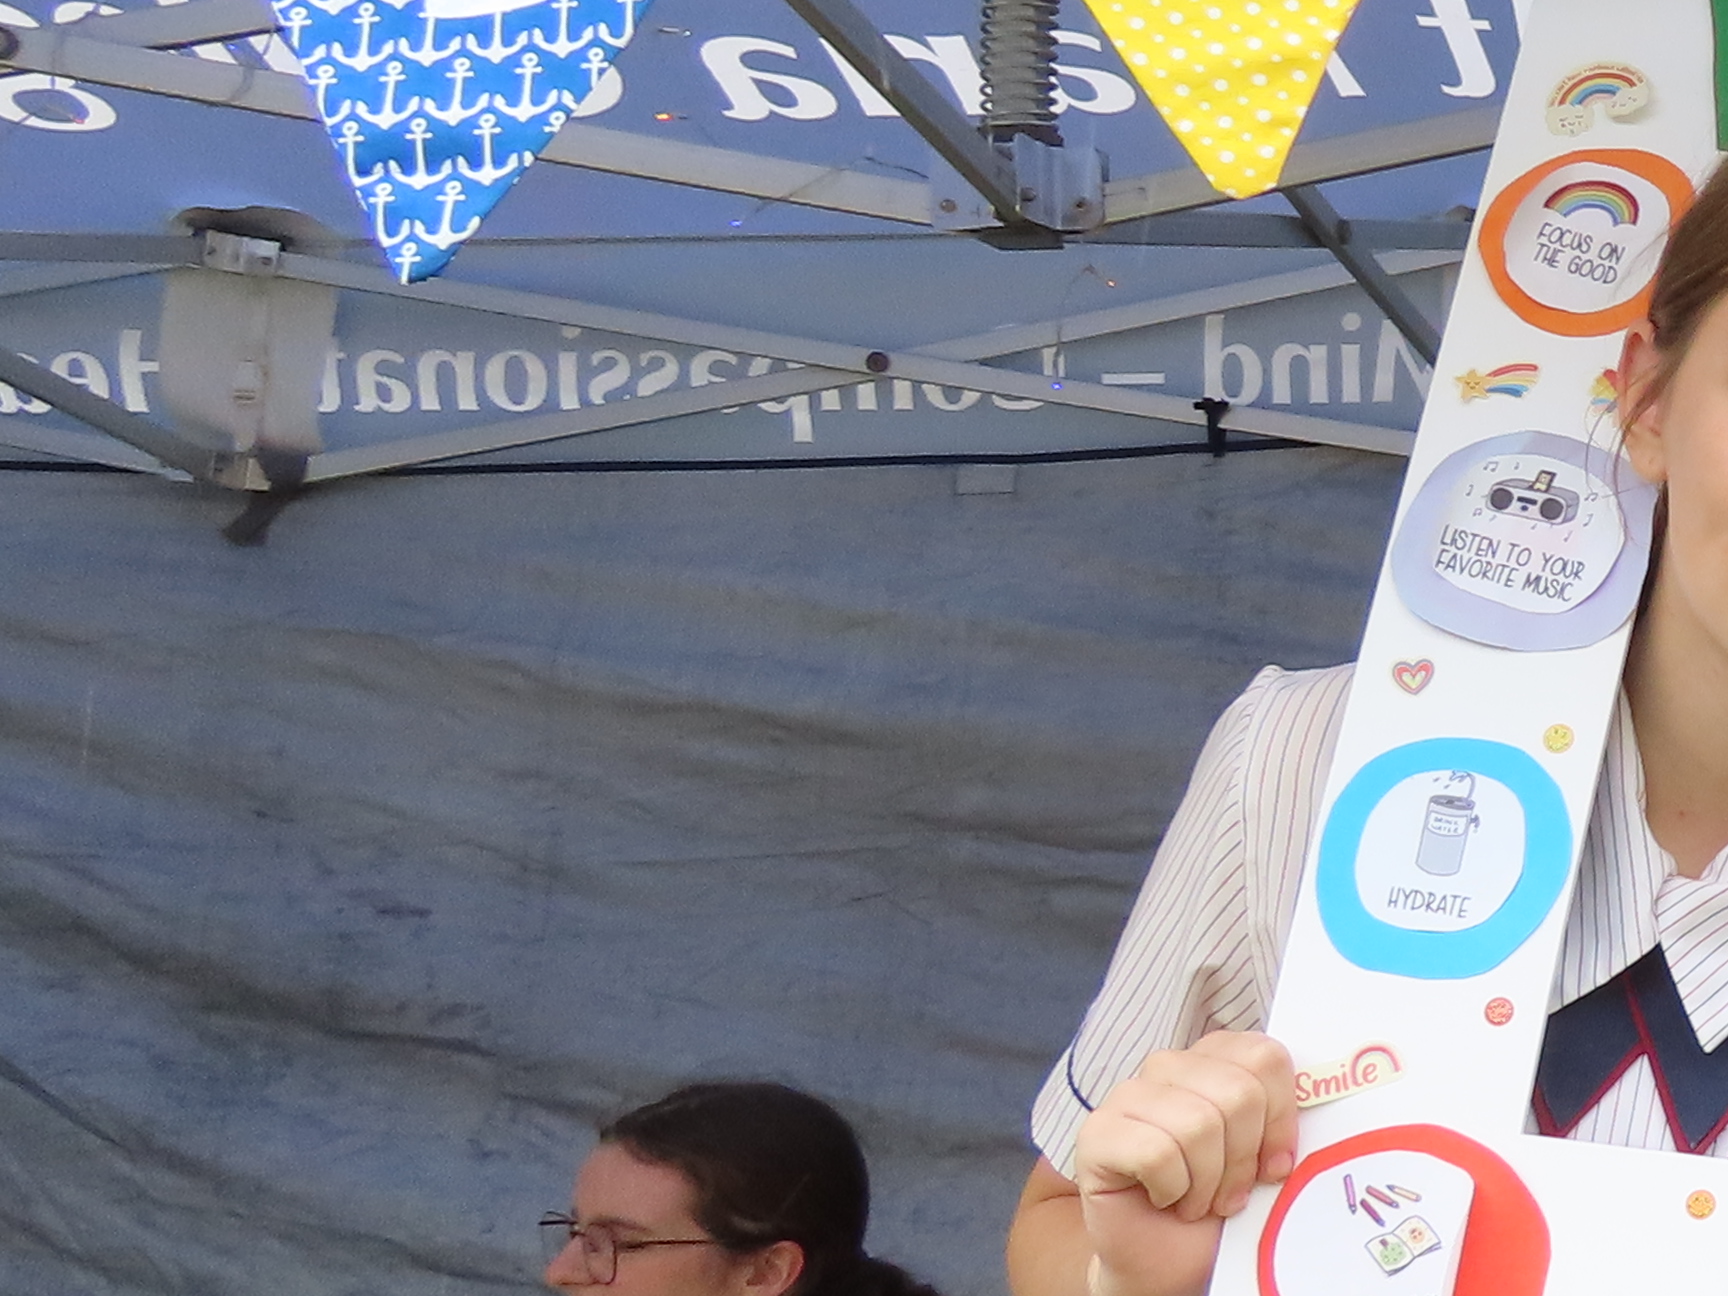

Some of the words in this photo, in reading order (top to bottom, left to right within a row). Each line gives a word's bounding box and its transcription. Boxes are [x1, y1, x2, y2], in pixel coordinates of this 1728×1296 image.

[1532, 241, 1566, 270] THE
[1567, 256, 1619, 284] GOOD
[1535, 221, 1594, 255] FOCUS
[1599, 240, 1627, 265] ON
[1440, 523, 1502, 560] LISTEN
[1505, 541, 1533, 568] TO
[1541, 552, 1587, 582] YOUR
[1434, 548, 1520, 589] FAVORITE
[1521, 572, 1575, 603] MUSIC
[1387, 885, 1472, 920] HYDRATE
[1294, 1059, 1379, 1102] Smile
